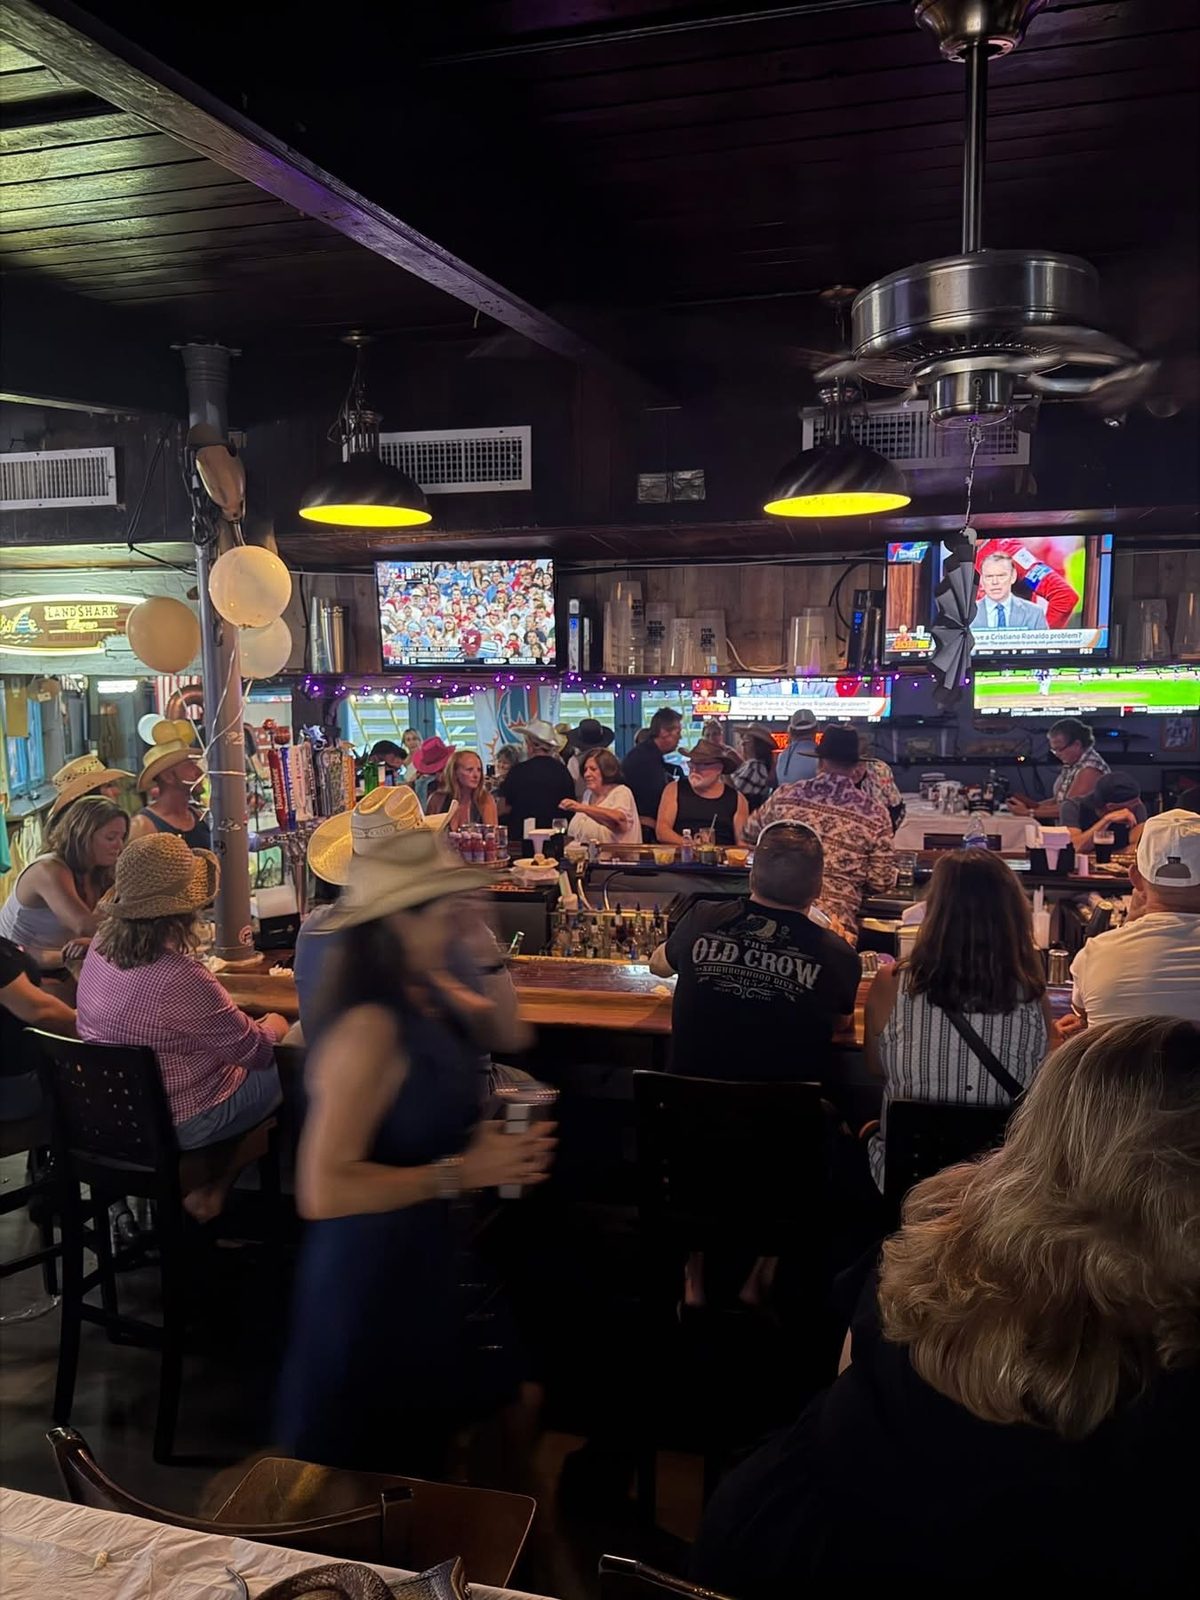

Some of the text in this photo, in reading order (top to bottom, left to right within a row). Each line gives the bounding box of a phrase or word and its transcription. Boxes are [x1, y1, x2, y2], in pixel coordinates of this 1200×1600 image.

[47, 605, 119, 618] LANDSHARK
[1021, 632, 1049, 640] Ronaldo
[1050, 632, 1082, 640] problem?
[271, 766, 284, 810] Budweiser
[743, 940, 768, 951] THE
[692, 938, 822, 990] OLD CROW
[702, 965, 770, 981] NEIGHBORHOOD
